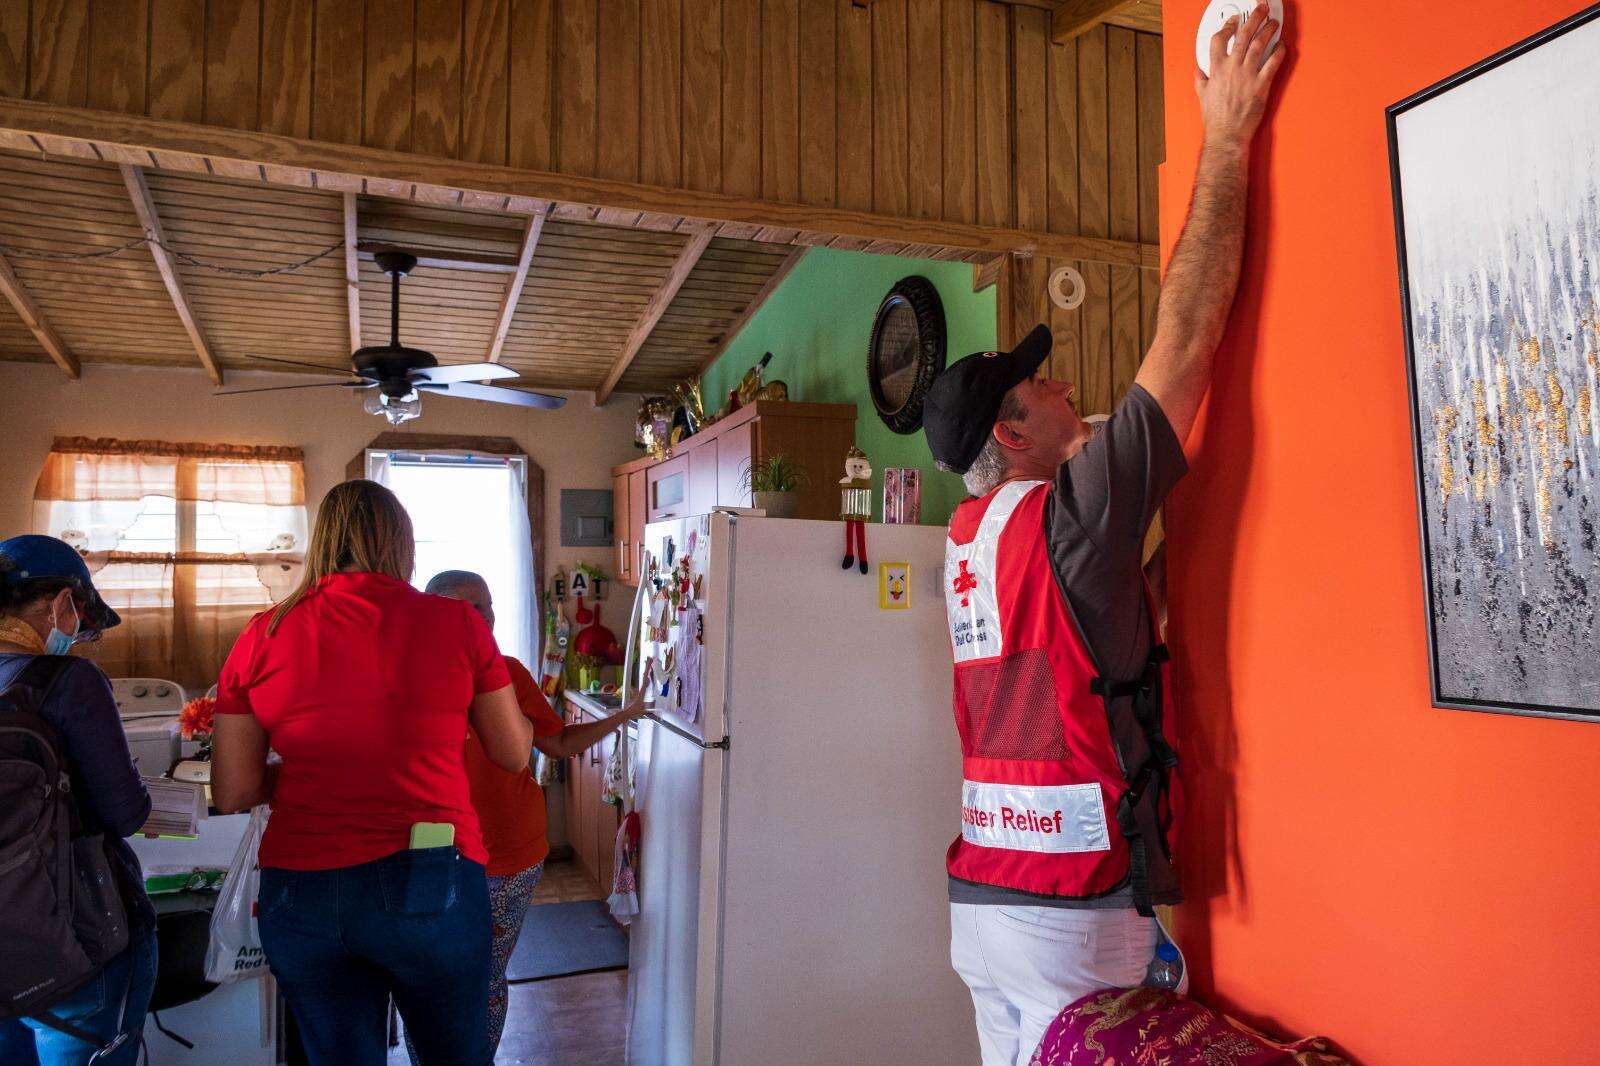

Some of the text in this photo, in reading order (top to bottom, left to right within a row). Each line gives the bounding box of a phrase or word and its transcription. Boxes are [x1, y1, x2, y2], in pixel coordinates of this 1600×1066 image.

[953, 618, 986, 633] erian
[1001, 806, 1062, 834] Relief
[234, 957, 263, 970] Red
